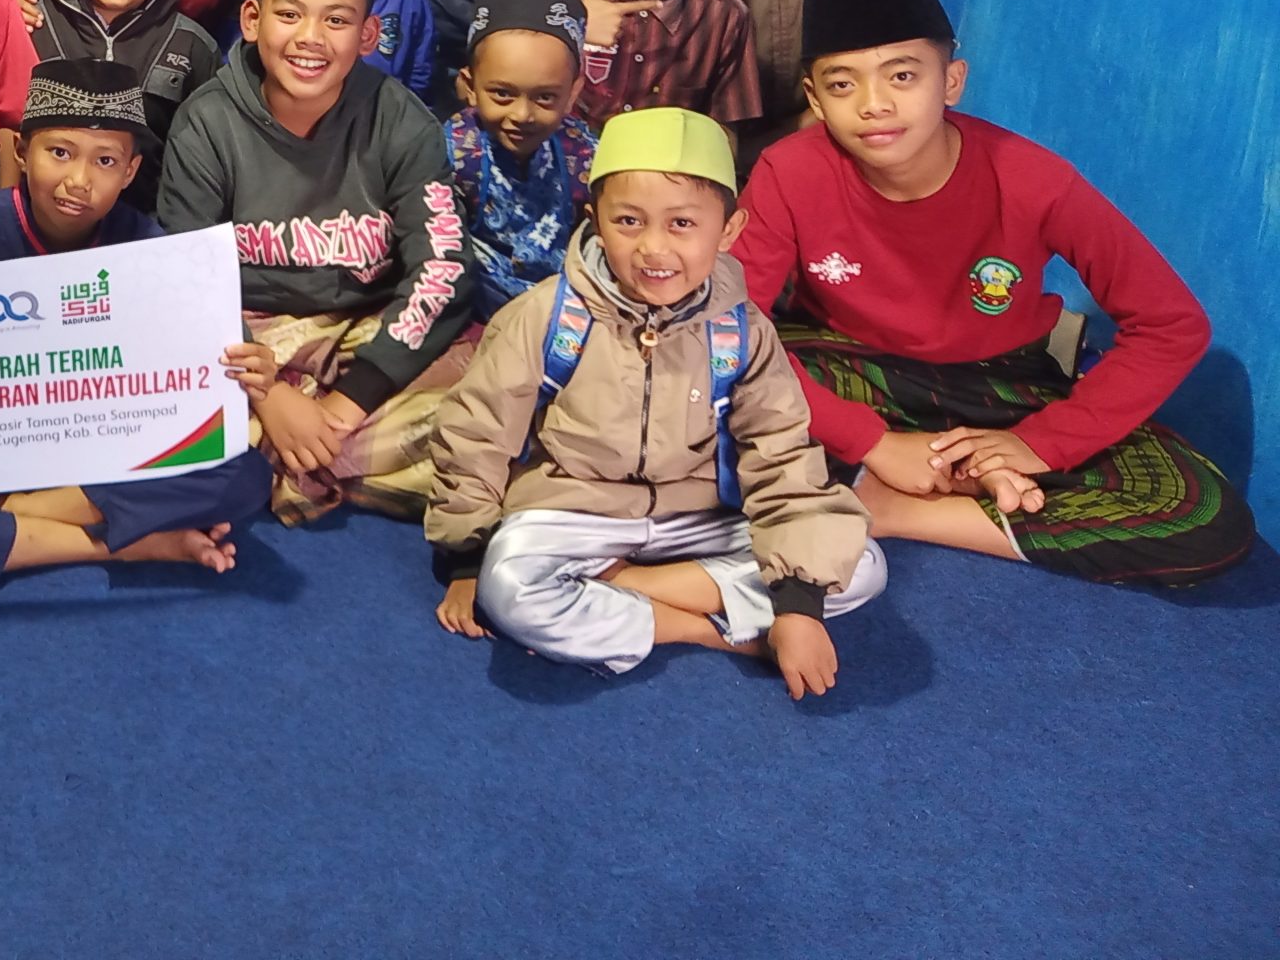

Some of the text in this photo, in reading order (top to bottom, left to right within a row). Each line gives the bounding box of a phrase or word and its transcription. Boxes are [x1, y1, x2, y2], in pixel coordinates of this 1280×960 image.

[62, 315, 111, 326] NADIFURQAN
[45, 345, 124, 374] TERIMA
[45, 367, 192, 405] HIDAYATULLAH
[197, 365, 210, 389] 2
[27, 415, 70, 428] Taman
[74, 412, 106, 424] Desa
[110, 403, 178, 421] Sarampad
[64, 427, 90, 440] Kab.
[97, 423, 142, 437] Cianjur
